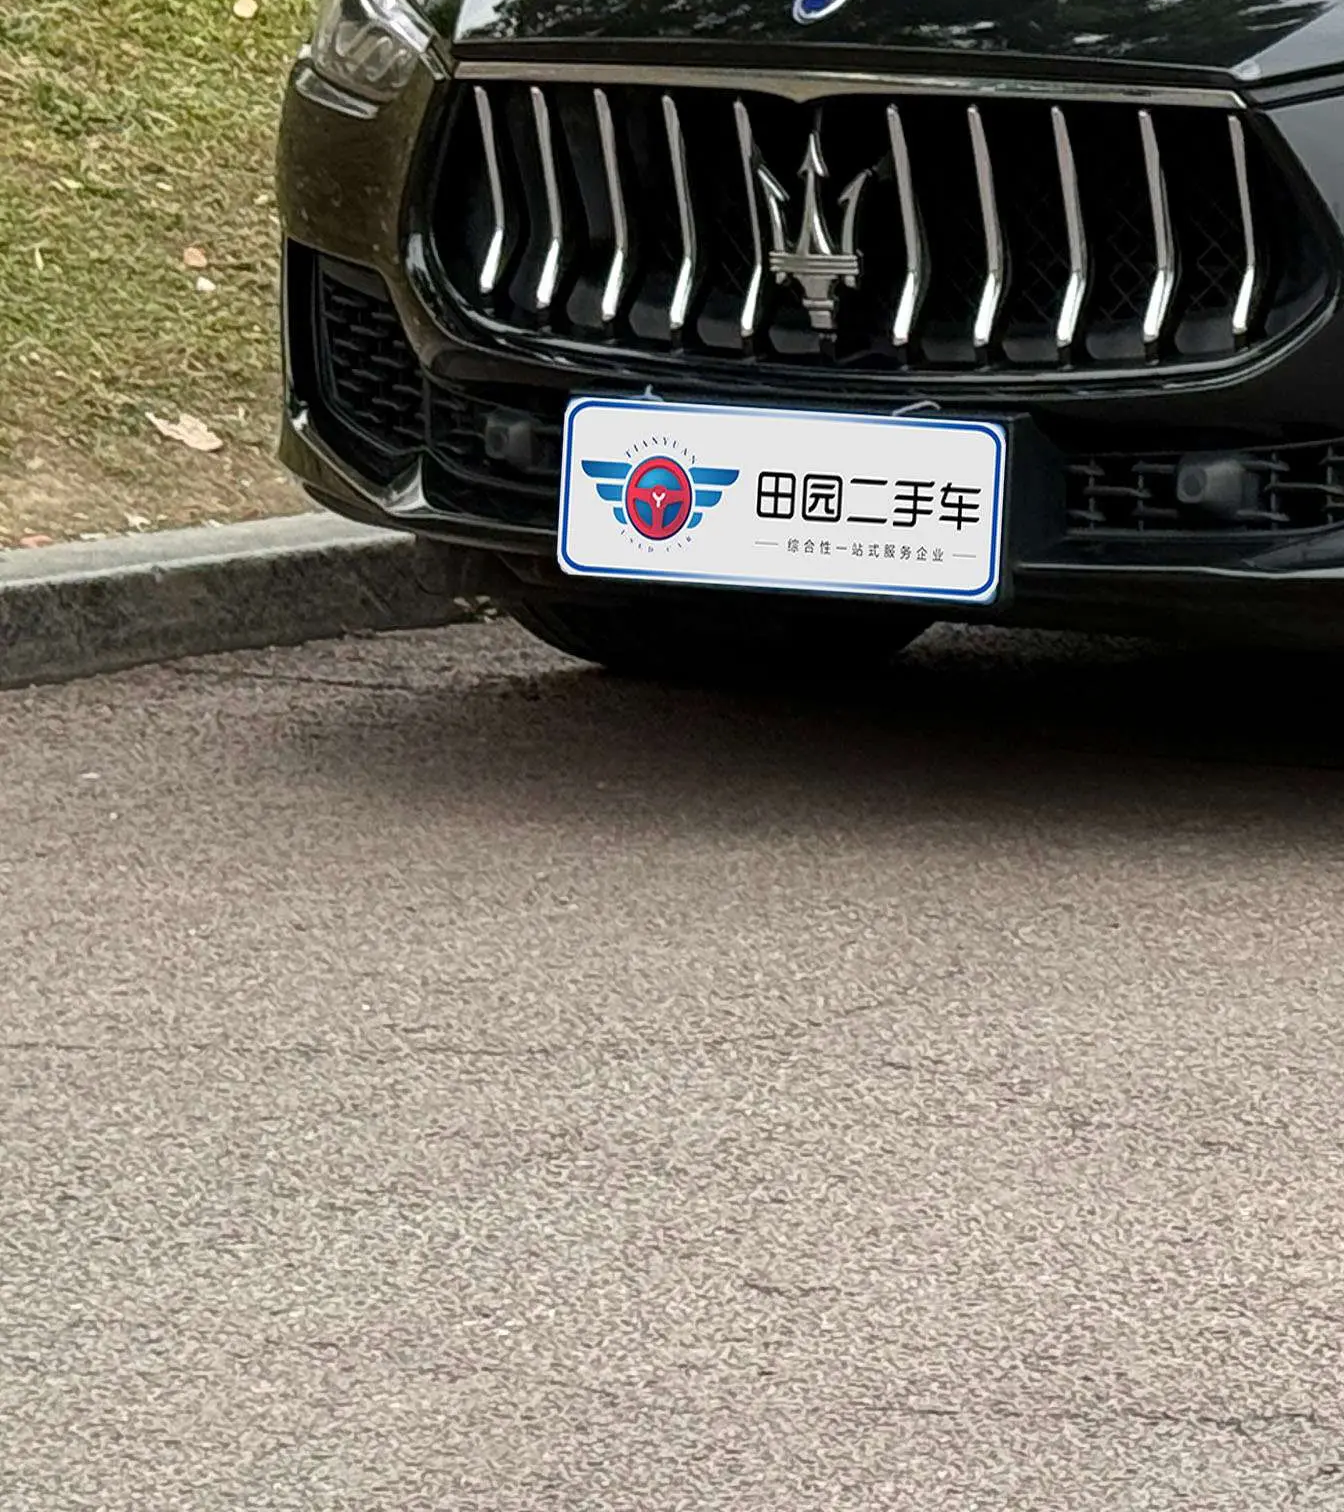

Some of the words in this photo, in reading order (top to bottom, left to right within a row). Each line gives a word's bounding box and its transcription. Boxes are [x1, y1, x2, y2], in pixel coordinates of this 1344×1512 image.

[756, 471, 982, 531] 田园二手车
[786, 537, 945, 563] 综合性一站式服务企业
